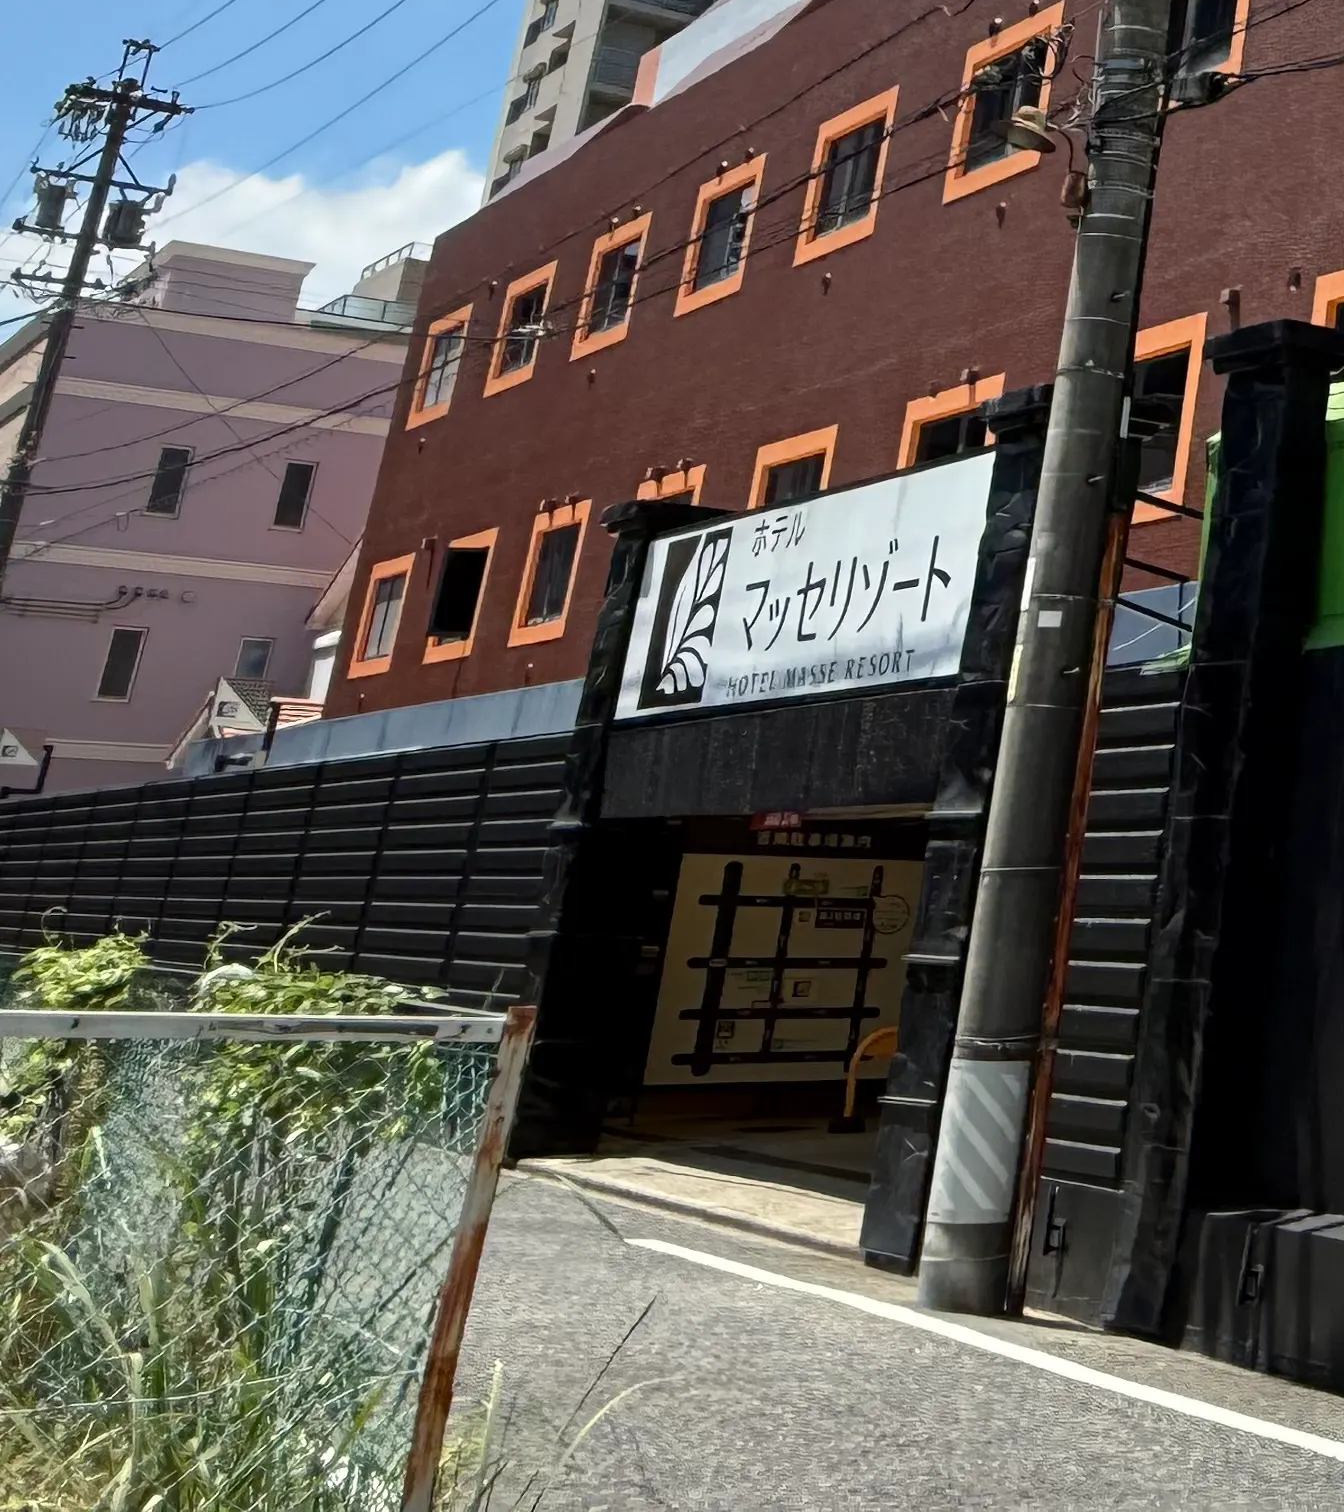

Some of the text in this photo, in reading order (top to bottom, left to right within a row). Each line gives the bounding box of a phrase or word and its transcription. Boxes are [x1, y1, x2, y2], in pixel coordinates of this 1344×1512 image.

[751, 511, 805, 557] ホテル
[742, 535, 951, 651] マッセリゾート
[726, 649, 915, 697] HOTEL MASSE RESORT
